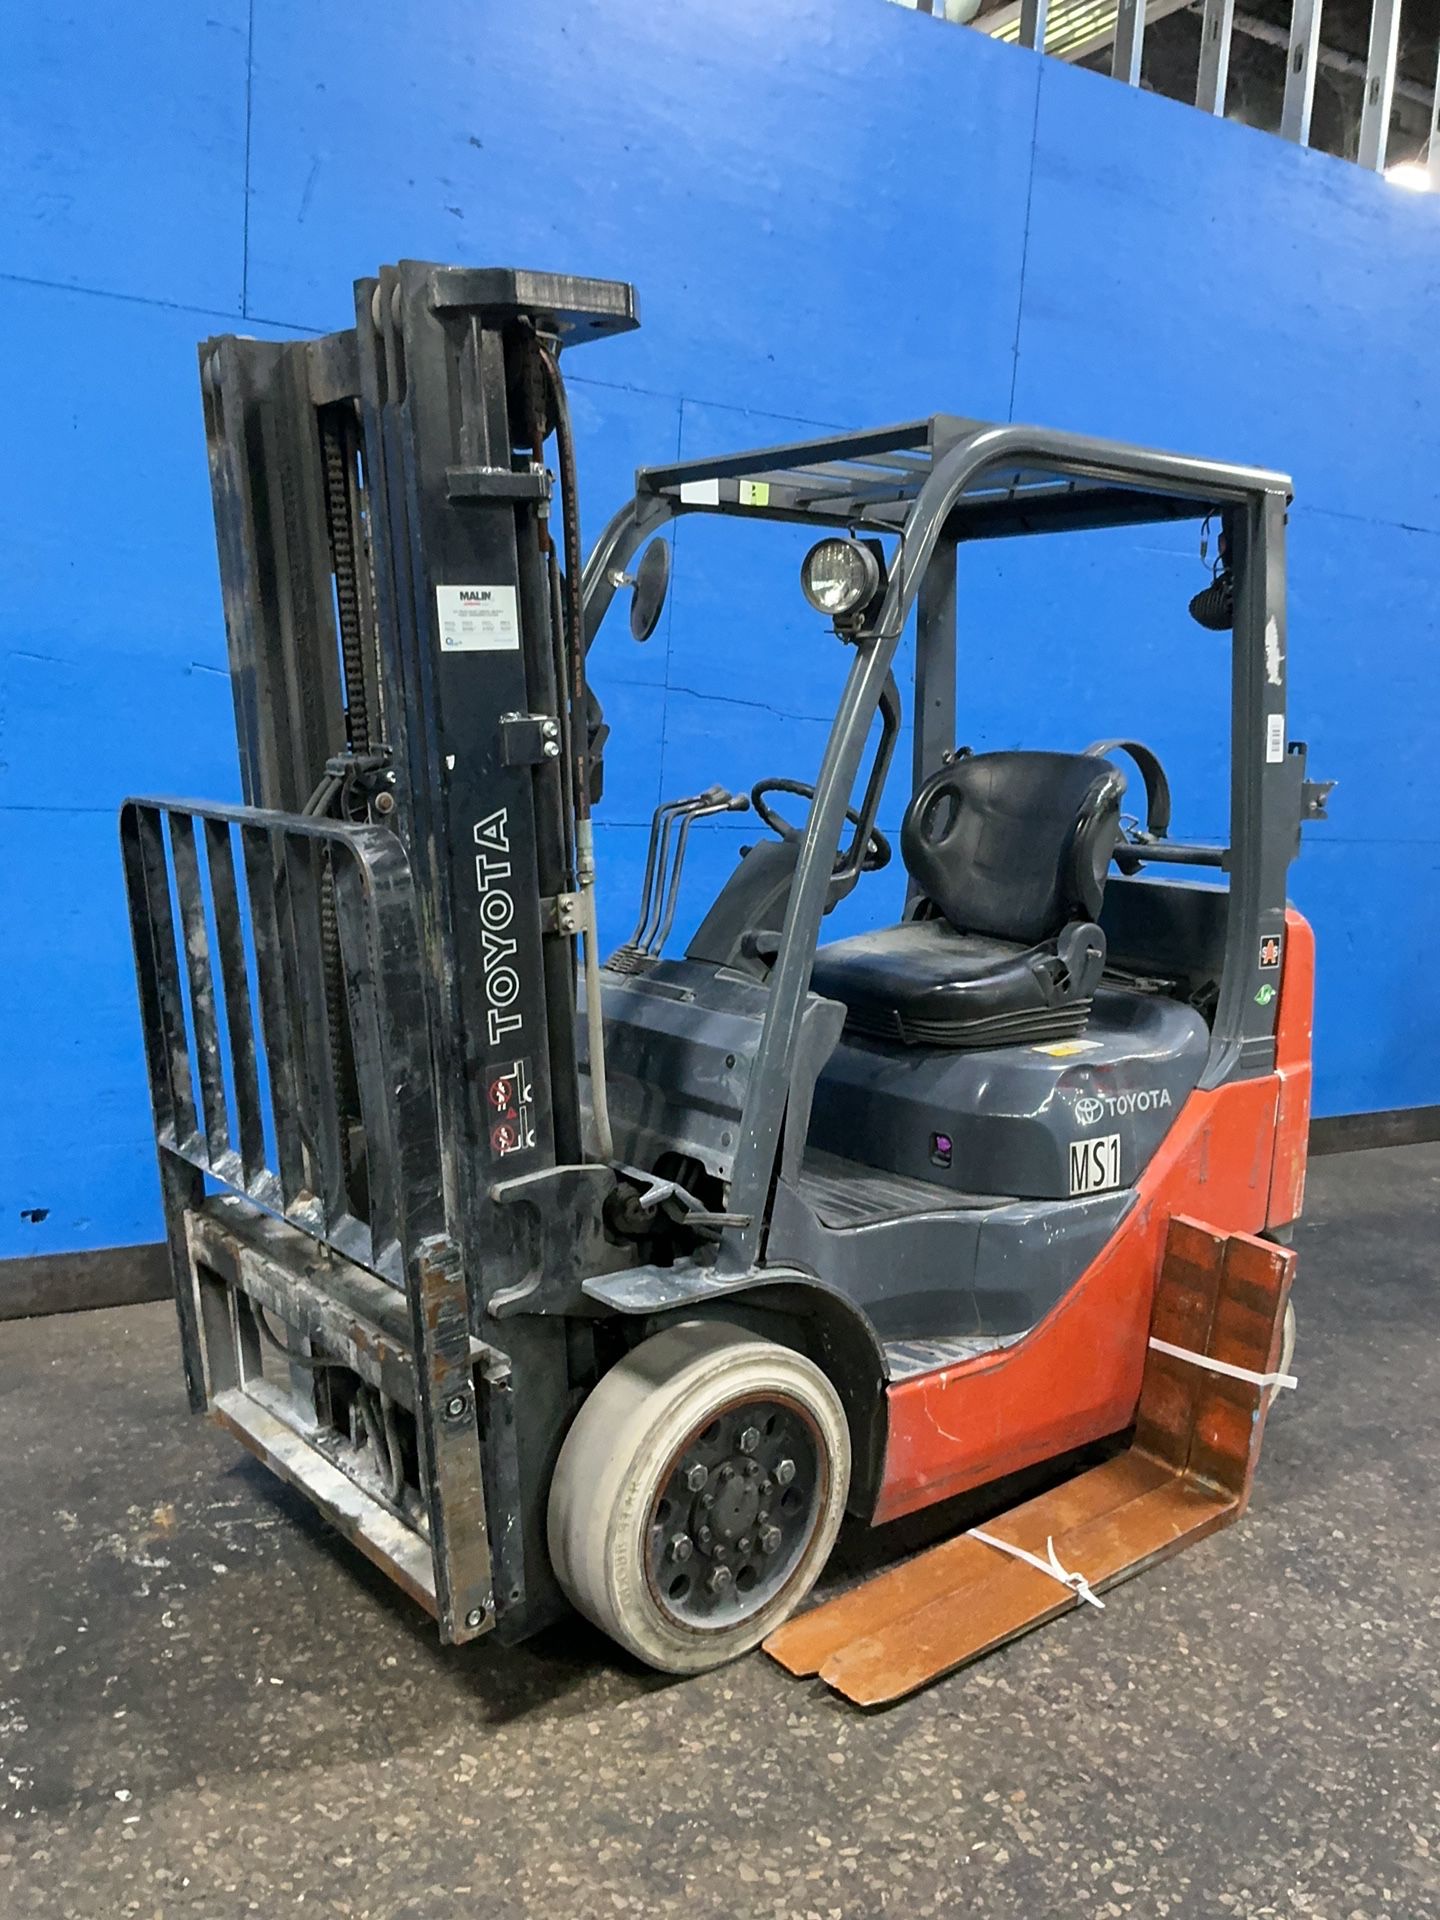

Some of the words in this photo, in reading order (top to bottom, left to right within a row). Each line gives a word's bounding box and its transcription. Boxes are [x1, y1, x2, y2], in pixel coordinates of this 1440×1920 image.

[460, 588, 491, 601] MALIN
[473, 807, 523, 1045] TOYOTA
[1105, 1088, 1172, 1117] TOYOTA
[1071, 1139, 1118, 1192] MS1
